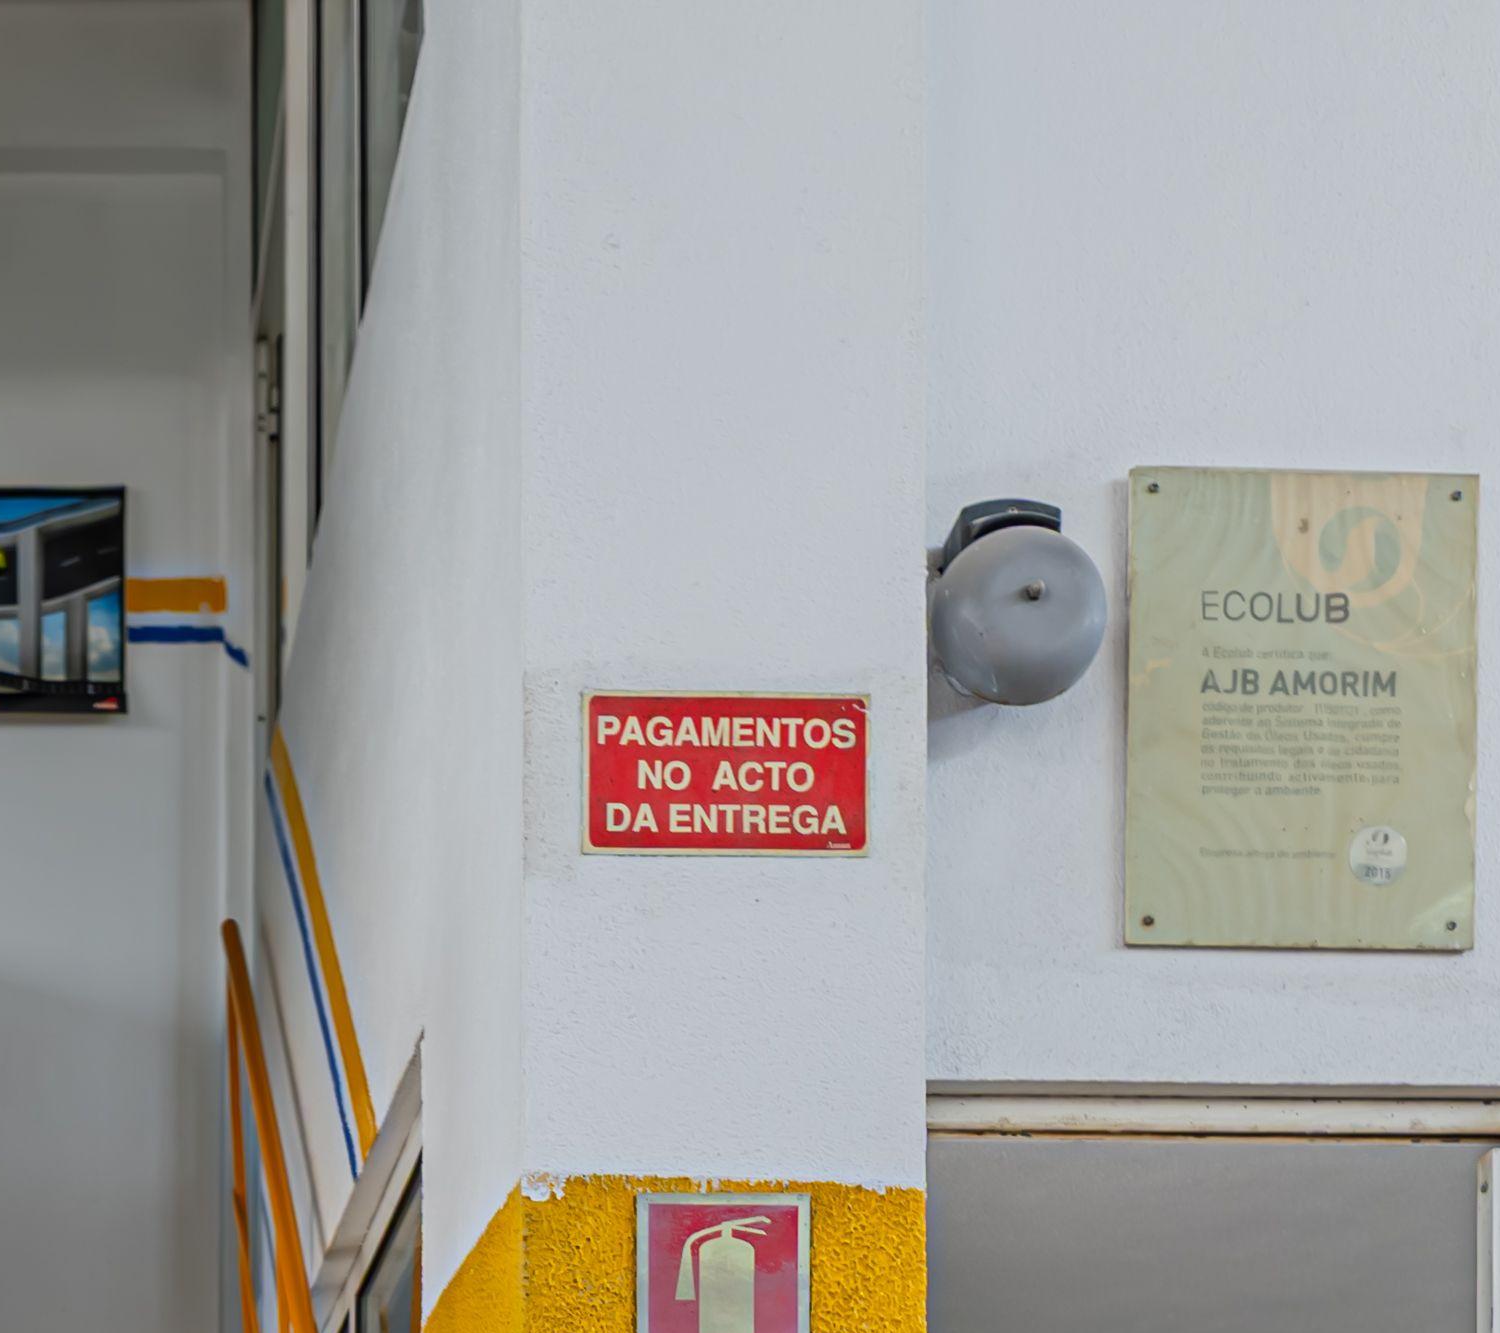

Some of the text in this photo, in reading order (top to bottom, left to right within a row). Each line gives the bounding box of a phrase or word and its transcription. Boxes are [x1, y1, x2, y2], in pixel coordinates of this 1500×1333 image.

[1201, 590, 1350, 623] ECOLUB
[1201, 669, 1397, 697] AJB AMORIM
[597, 715, 857, 749] PAGAMENTOS
[637, 759, 815, 793] NO ACTO
[606, 802, 847, 835] DA ENTREGA
